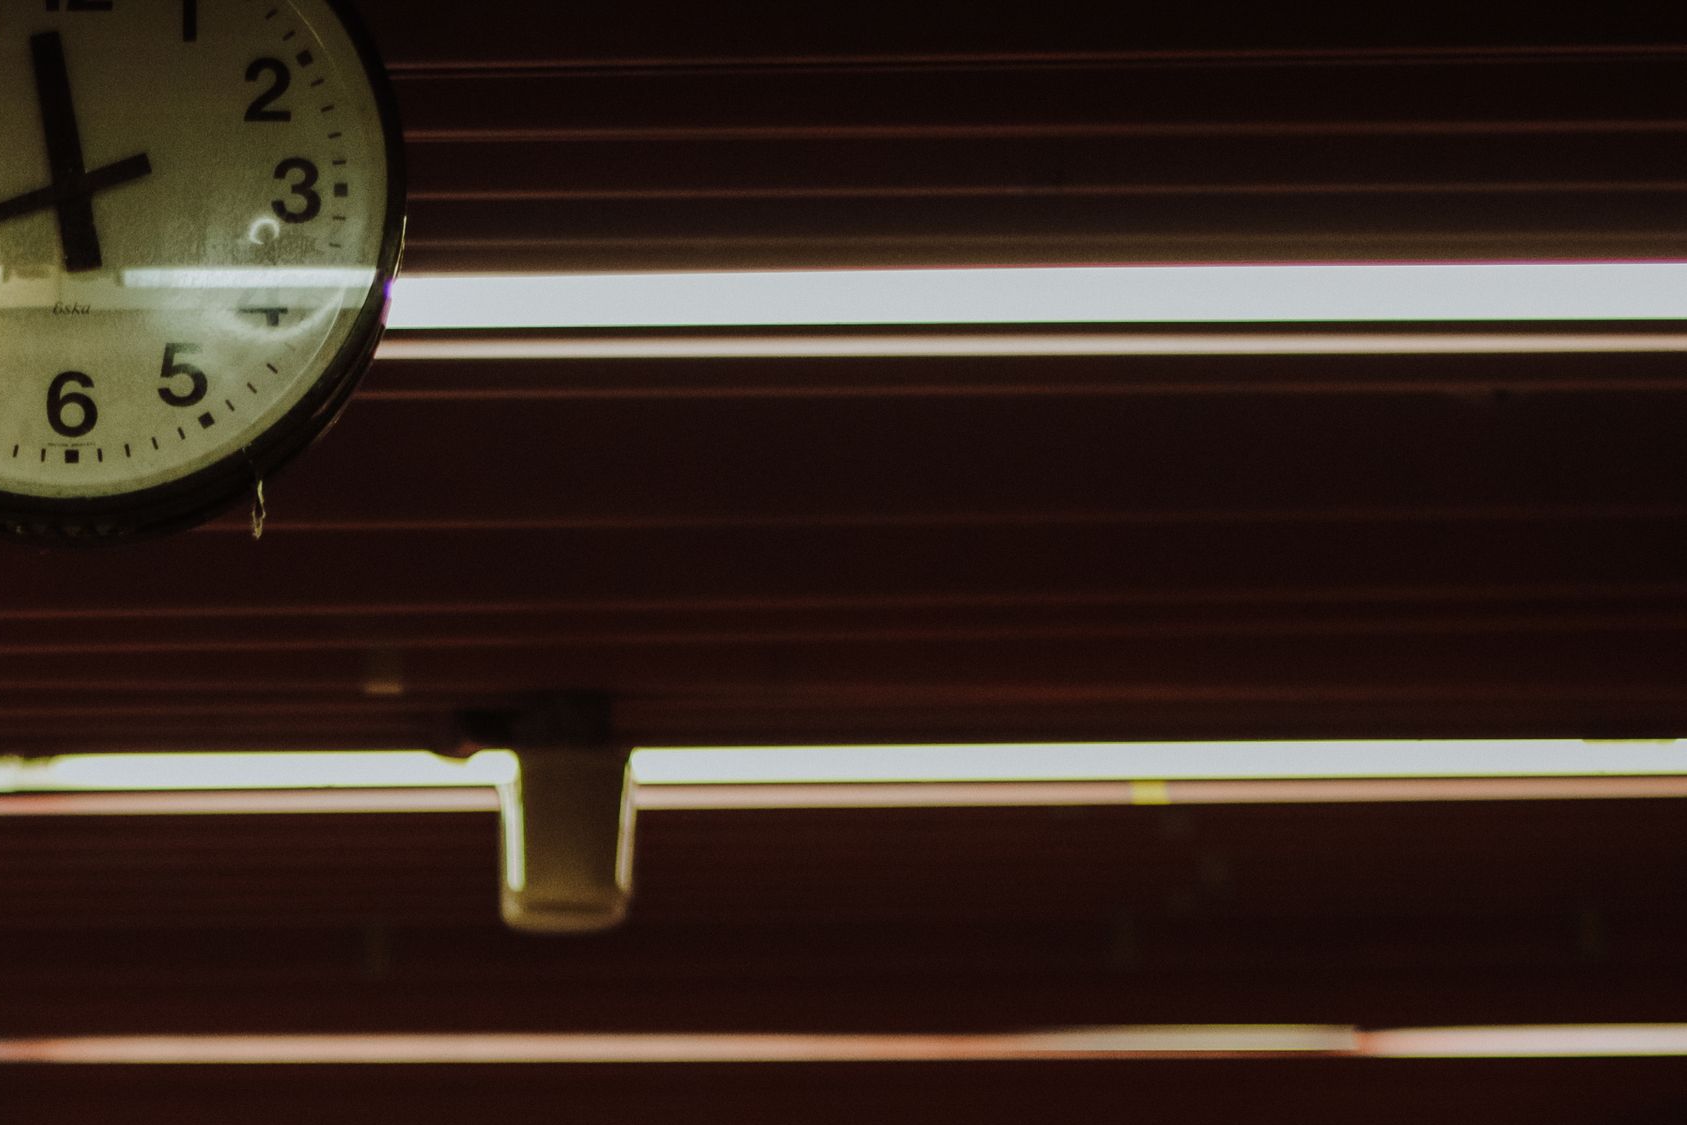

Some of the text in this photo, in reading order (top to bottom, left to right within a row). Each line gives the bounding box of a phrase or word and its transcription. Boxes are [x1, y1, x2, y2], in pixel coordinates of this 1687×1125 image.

[244, 58, 292, 122] 2
[272, 158, 321, 223] 3
[47, 371, 99, 437] 6
[158, 343, 208, 407] 5
